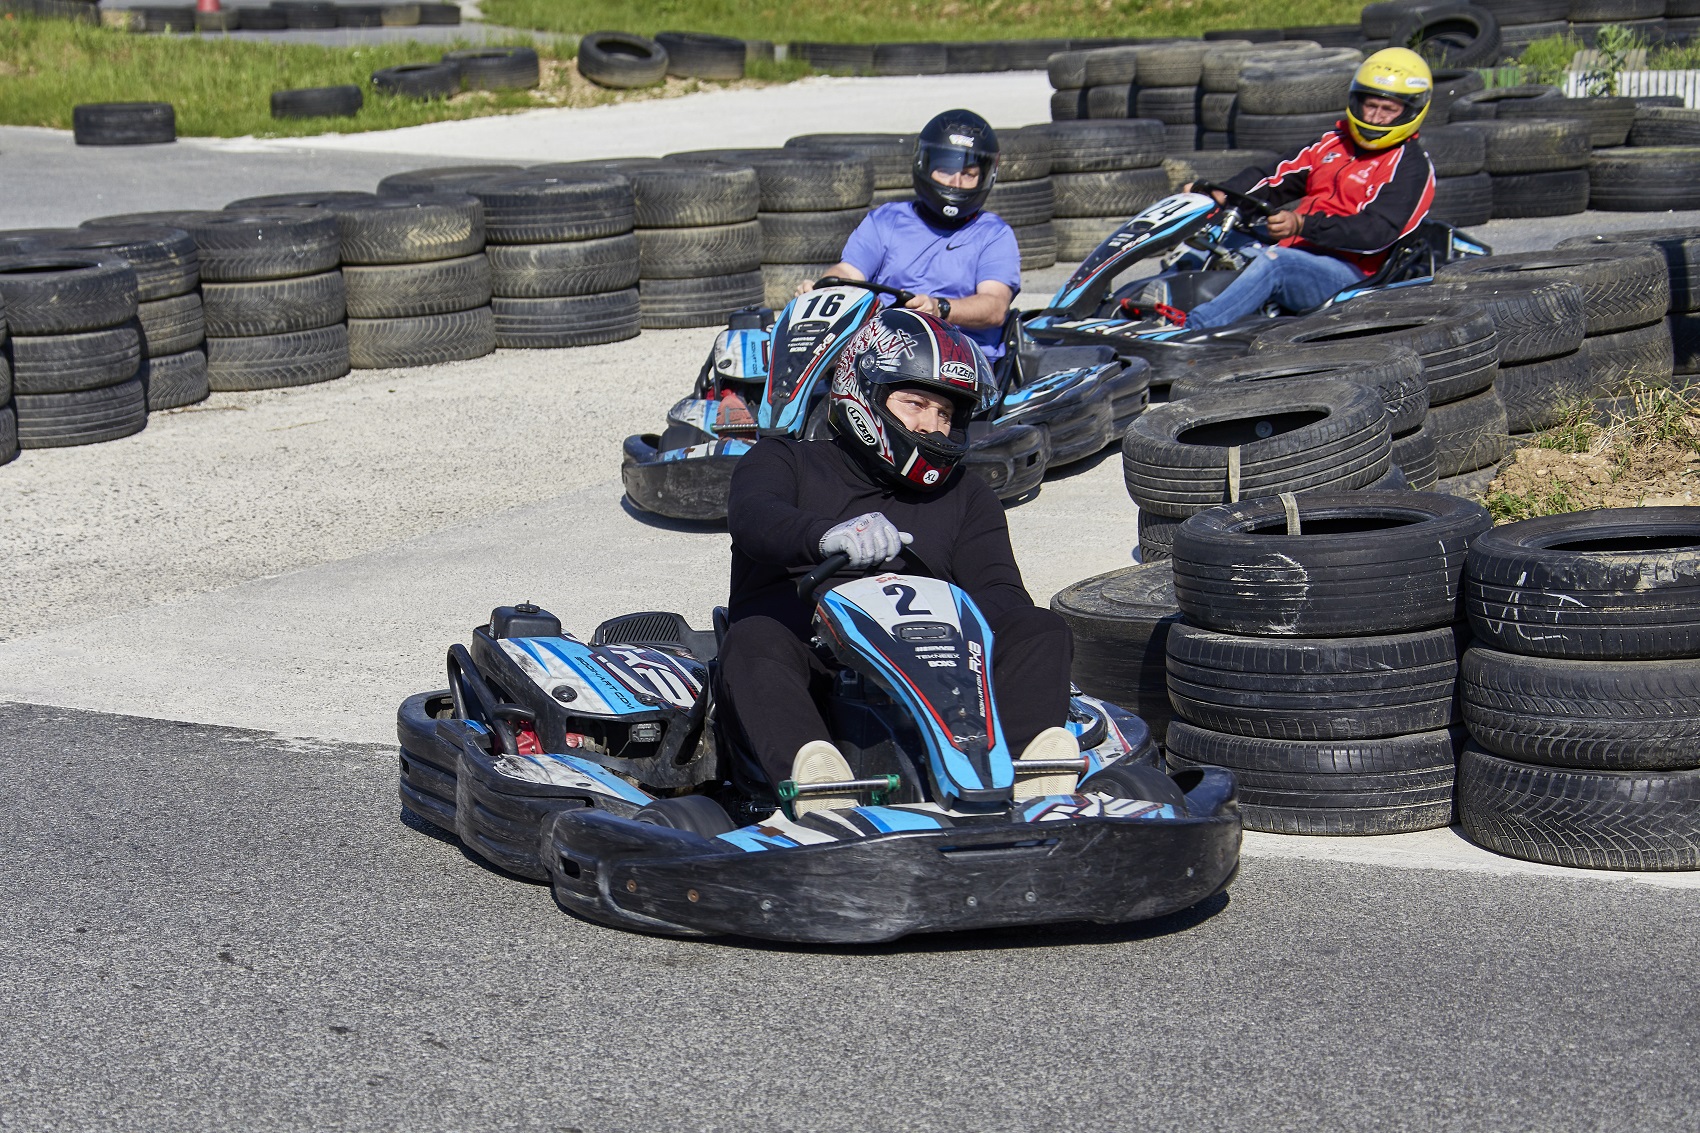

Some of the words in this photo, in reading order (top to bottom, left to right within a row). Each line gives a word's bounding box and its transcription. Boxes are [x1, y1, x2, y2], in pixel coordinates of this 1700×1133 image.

[801, 293, 845, 320] 16
[945, 363, 975, 381] LAZER
[849, 407, 875, 444] LAZER
[925, 472, 936, 482] XL
[882, 583, 933, 616] 2
[968, 640, 982, 674] RX8
